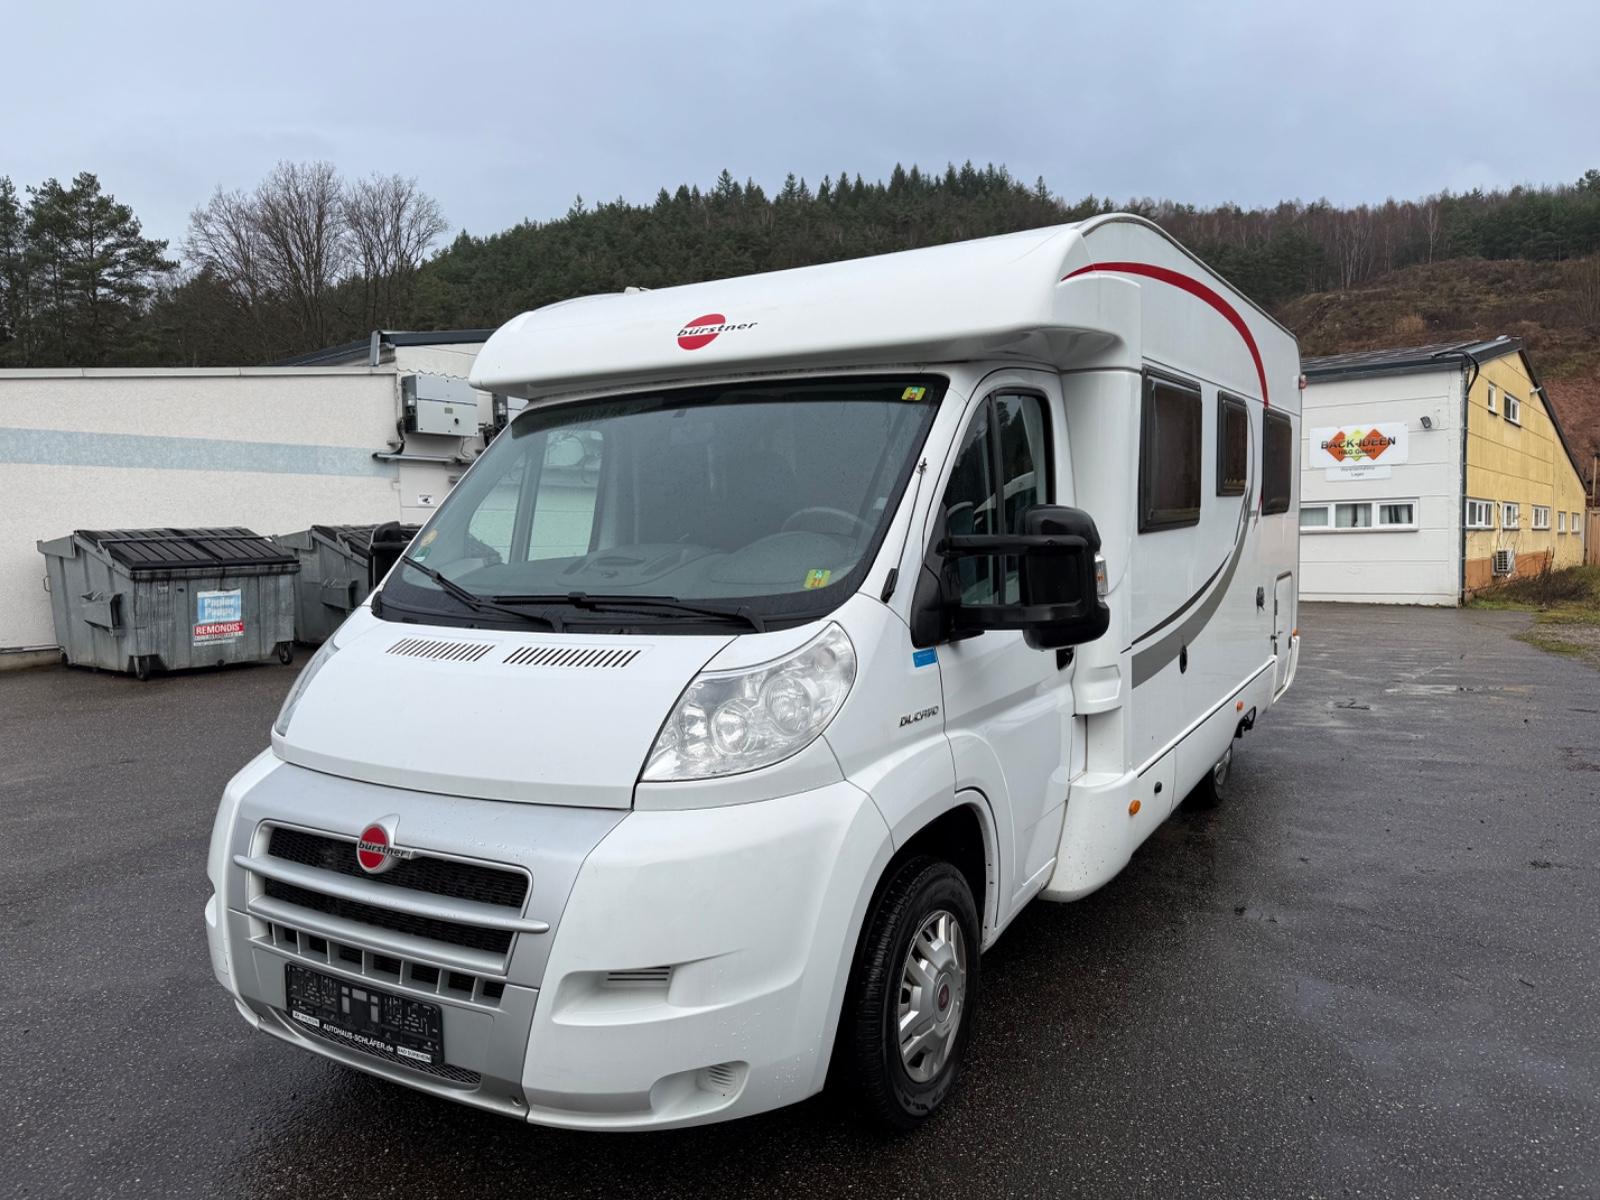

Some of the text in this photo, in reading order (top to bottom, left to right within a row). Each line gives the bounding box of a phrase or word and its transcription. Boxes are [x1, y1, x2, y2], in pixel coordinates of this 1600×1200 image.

[677, 322, 758, 336] bürstner
[1320, 436, 1396, 450] BACK-IDEEN
[358, 840, 404, 857] bürstner
